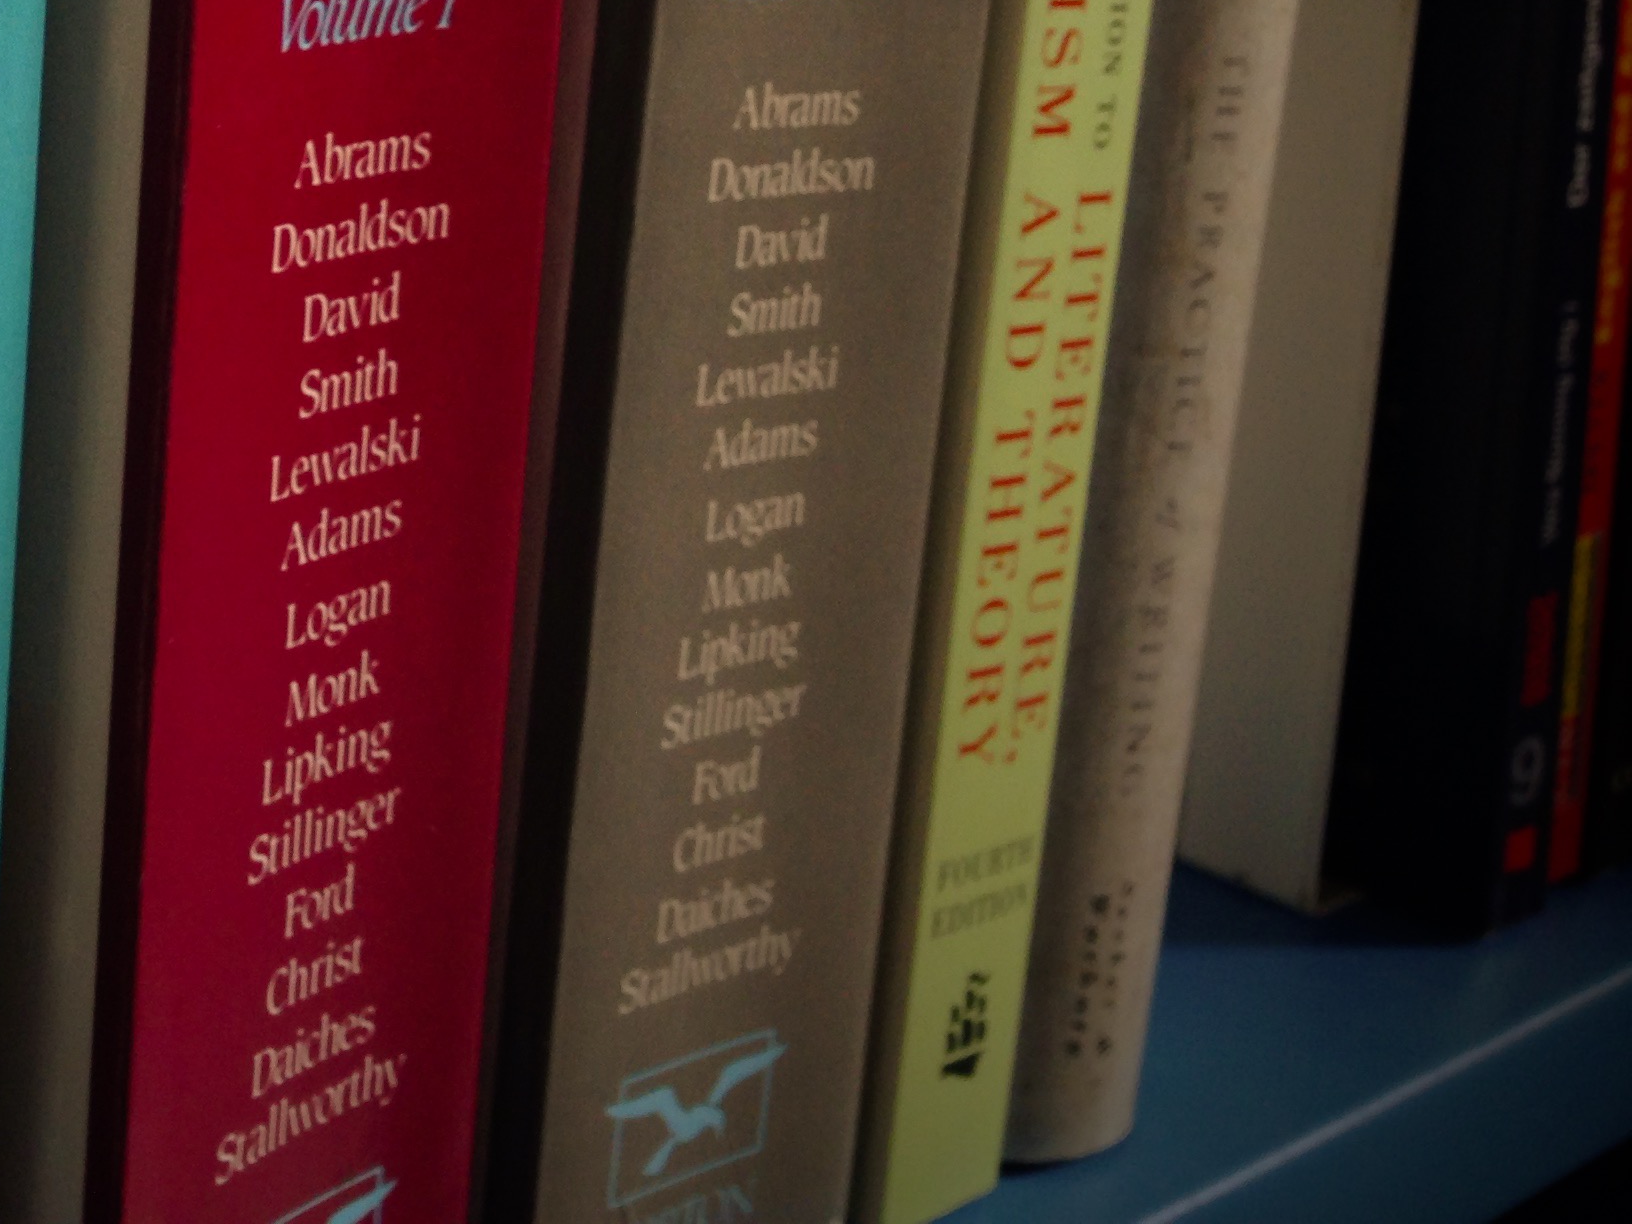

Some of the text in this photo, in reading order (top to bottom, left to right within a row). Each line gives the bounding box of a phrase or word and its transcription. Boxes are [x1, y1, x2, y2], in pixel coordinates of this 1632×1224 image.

[733, 82, 861, 131] Abrams
[294, 132, 432, 189] Abrams
[708, 147, 875, 203] Donaldson
[271, 198, 450, 274] Donaldson
[735, 213, 829, 270] David
[303, 270, 401, 343] David
[727, 282, 822, 337] Smith
[1005, 192, 1061, 369] AND
[299, 347, 399, 419] Smith
[695, 345, 840, 407] Lewalski
[269, 413, 421, 502] Lewalski
[703, 418, 819, 471] Adams
[280, 499, 403, 571] Adams
[705, 492, 806, 547] Logan
[285, 580, 391, 650] Logan
[701, 553, 792, 613] Monk
[958, 408, 1036, 766] THEORY
[677, 619, 801, 684] Lipking
[285, 650, 380, 727] Monk
[660, 683, 807, 750] Stillinger
[262, 720, 393, 806] Lipking
[247, 786, 402, 886] Stillinger
[672, 812, 765, 874] Christ
[285, 862, 356, 938] Ford
[266, 936, 363, 1017] Christ
[252, 1005, 377, 1099] Daiches
[215, 1053, 409, 1186] Stallworthy
